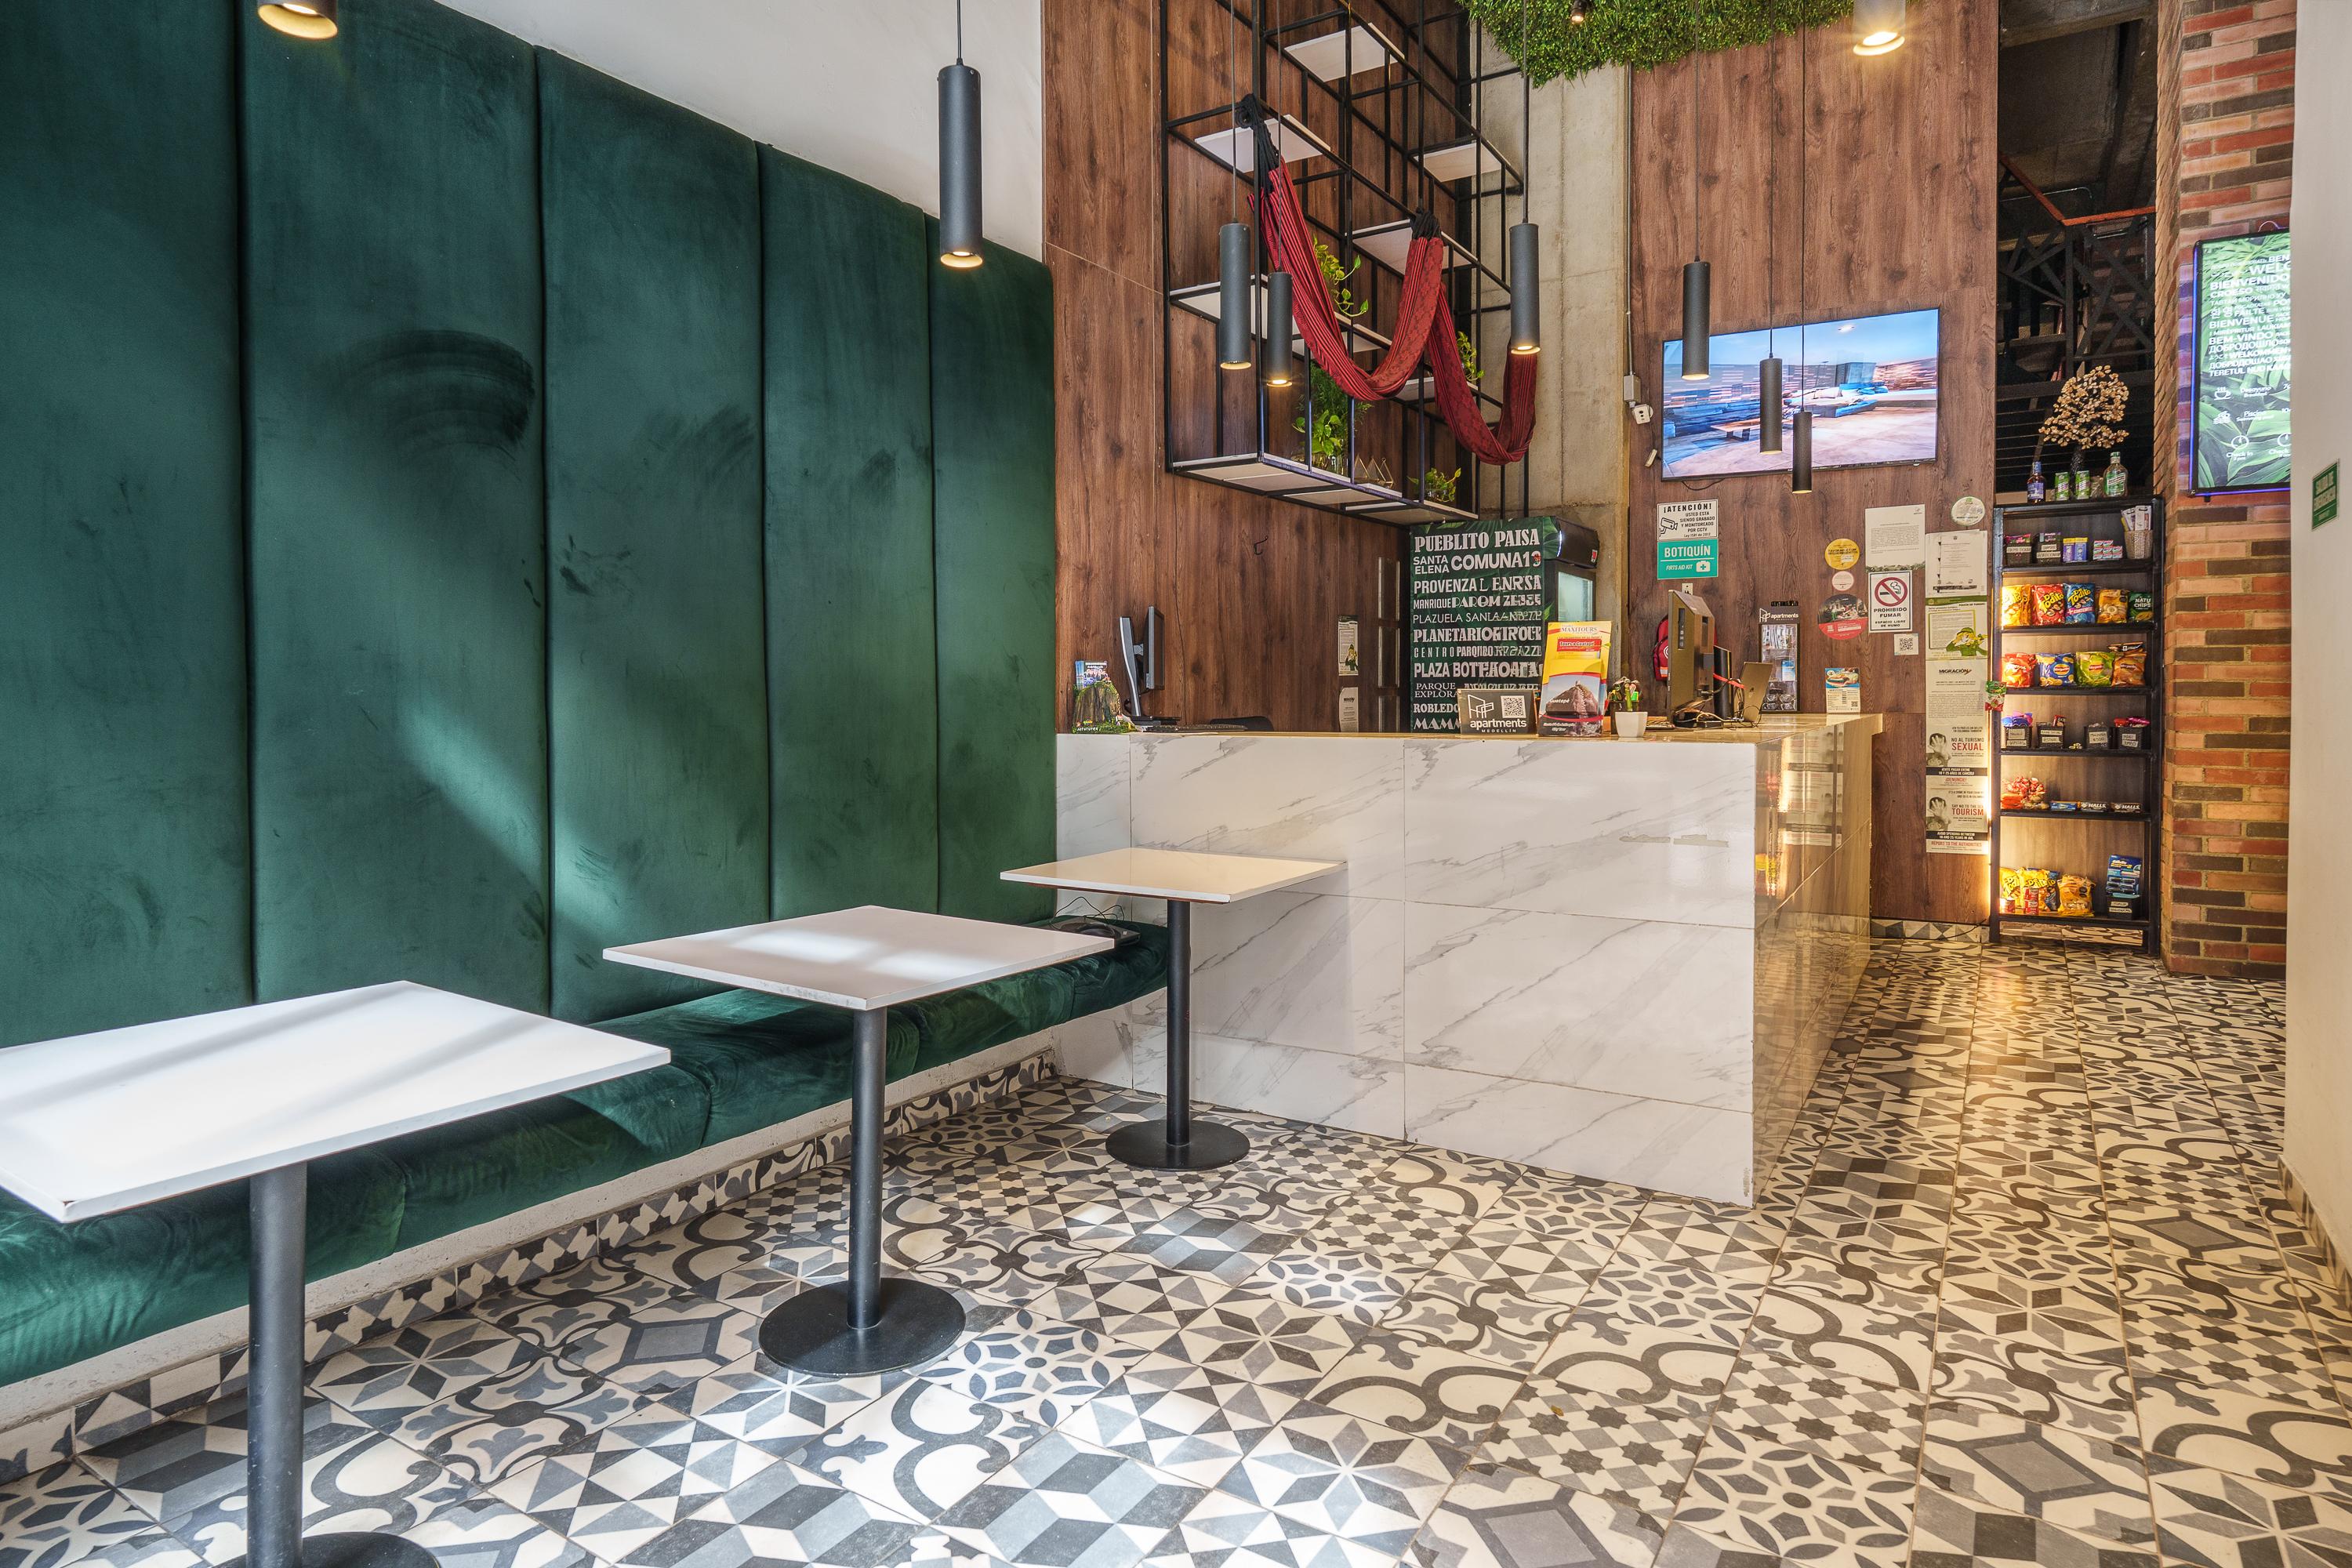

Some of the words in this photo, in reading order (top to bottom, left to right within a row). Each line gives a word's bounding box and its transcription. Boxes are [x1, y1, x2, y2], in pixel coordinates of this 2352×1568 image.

[2209, 314, 2274, 329] BIENVENUE
[2209, 331, 2273, 345] BEM-VINDO
[1664, 503, 1711, 513] ¡ATENCIÓN!
[1414, 532, 1490, 553] PUEBLITO
[1494, 528, 1540, 548] PAISA
[1664, 543, 1711, 557] BOTIQUÍN
[1413, 555, 1448, 565] SANTA
[1414, 564, 1450, 575] ELENA
[1414, 578, 1477, 594] PROVENZA
[1413, 597, 1451, 610] MANRIQUE
[2068, 589, 2091, 606] Todito
[1413, 613, 1463, 624] PLAZUELA
[1414, 646, 1454, 658] CENTRO
[1414, 662, 1450, 678] PLAZA
[1417, 682, 1456, 691] PARQUE
[1414, 690, 1459, 699] EXPLORA
[1470, 718, 1527, 731] apartments
